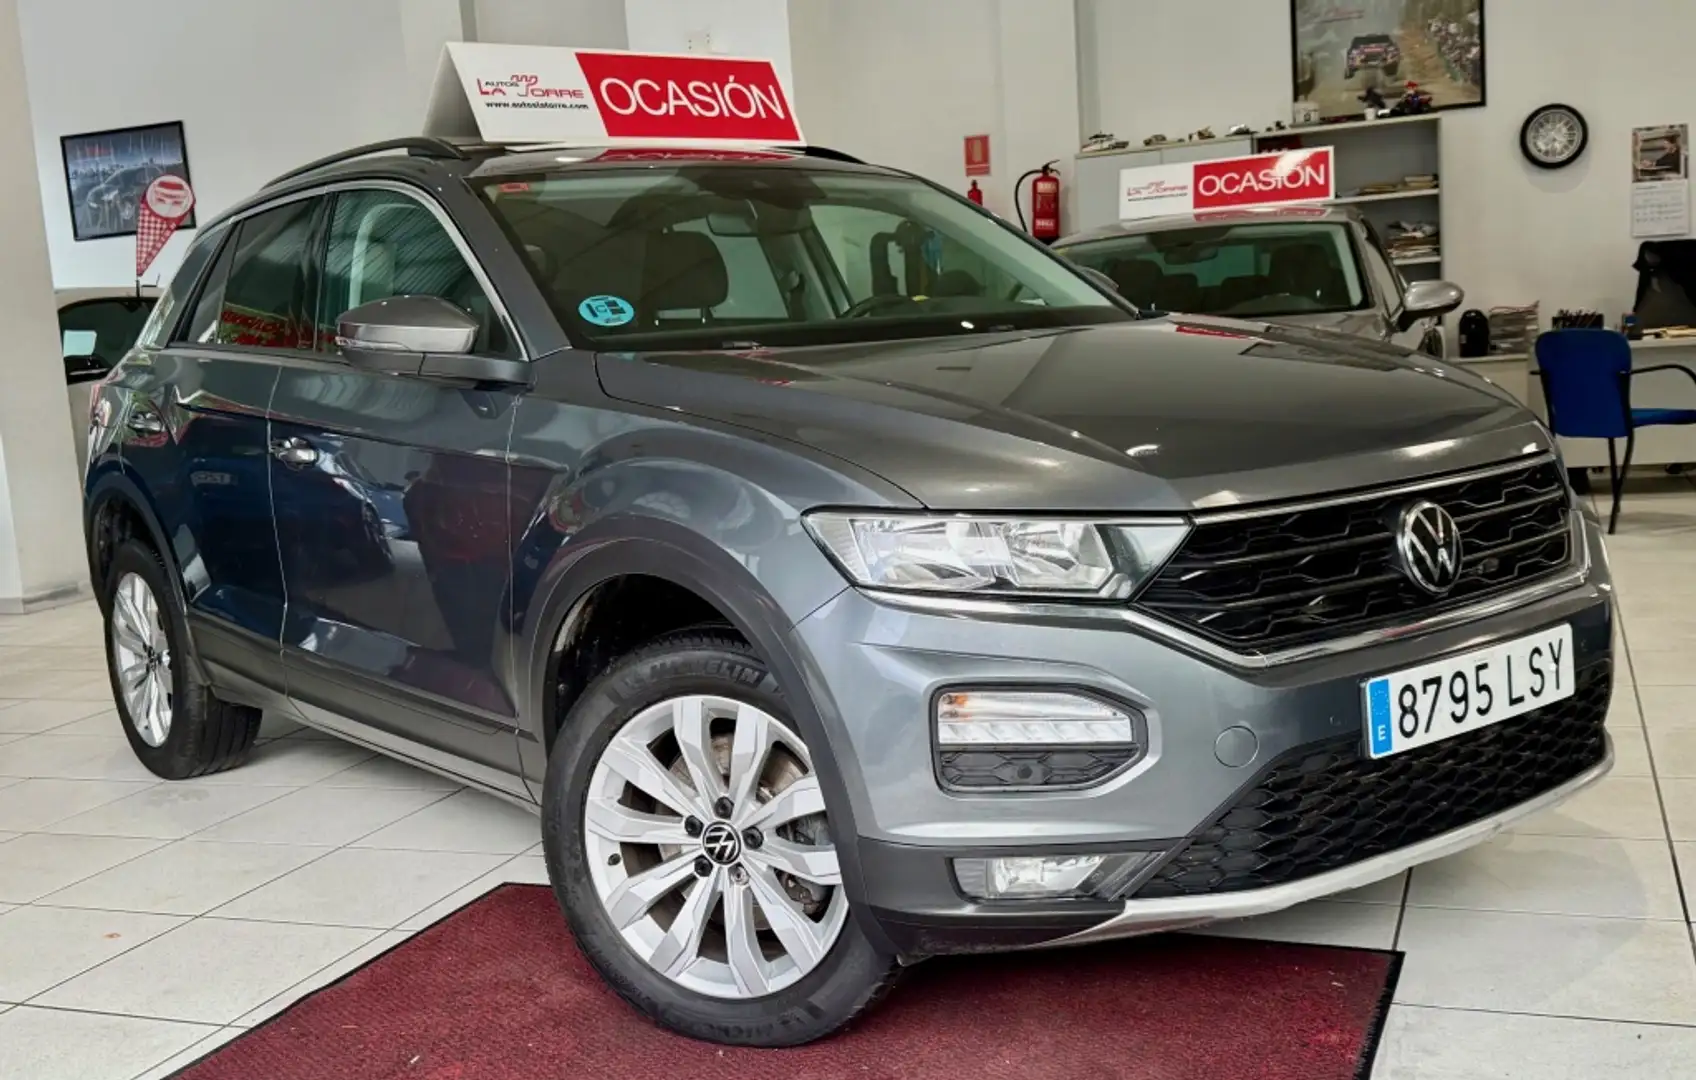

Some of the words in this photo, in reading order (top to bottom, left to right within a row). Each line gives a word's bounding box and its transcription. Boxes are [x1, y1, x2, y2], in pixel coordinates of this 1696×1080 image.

[476, 78, 507, 96] LA
[599, 75, 786, 121] OCASIÓN
[1398, 662, 1494, 739] 8795
[1506, 637, 1564, 708] LSY
[1376, 723, 1387, 741] E
